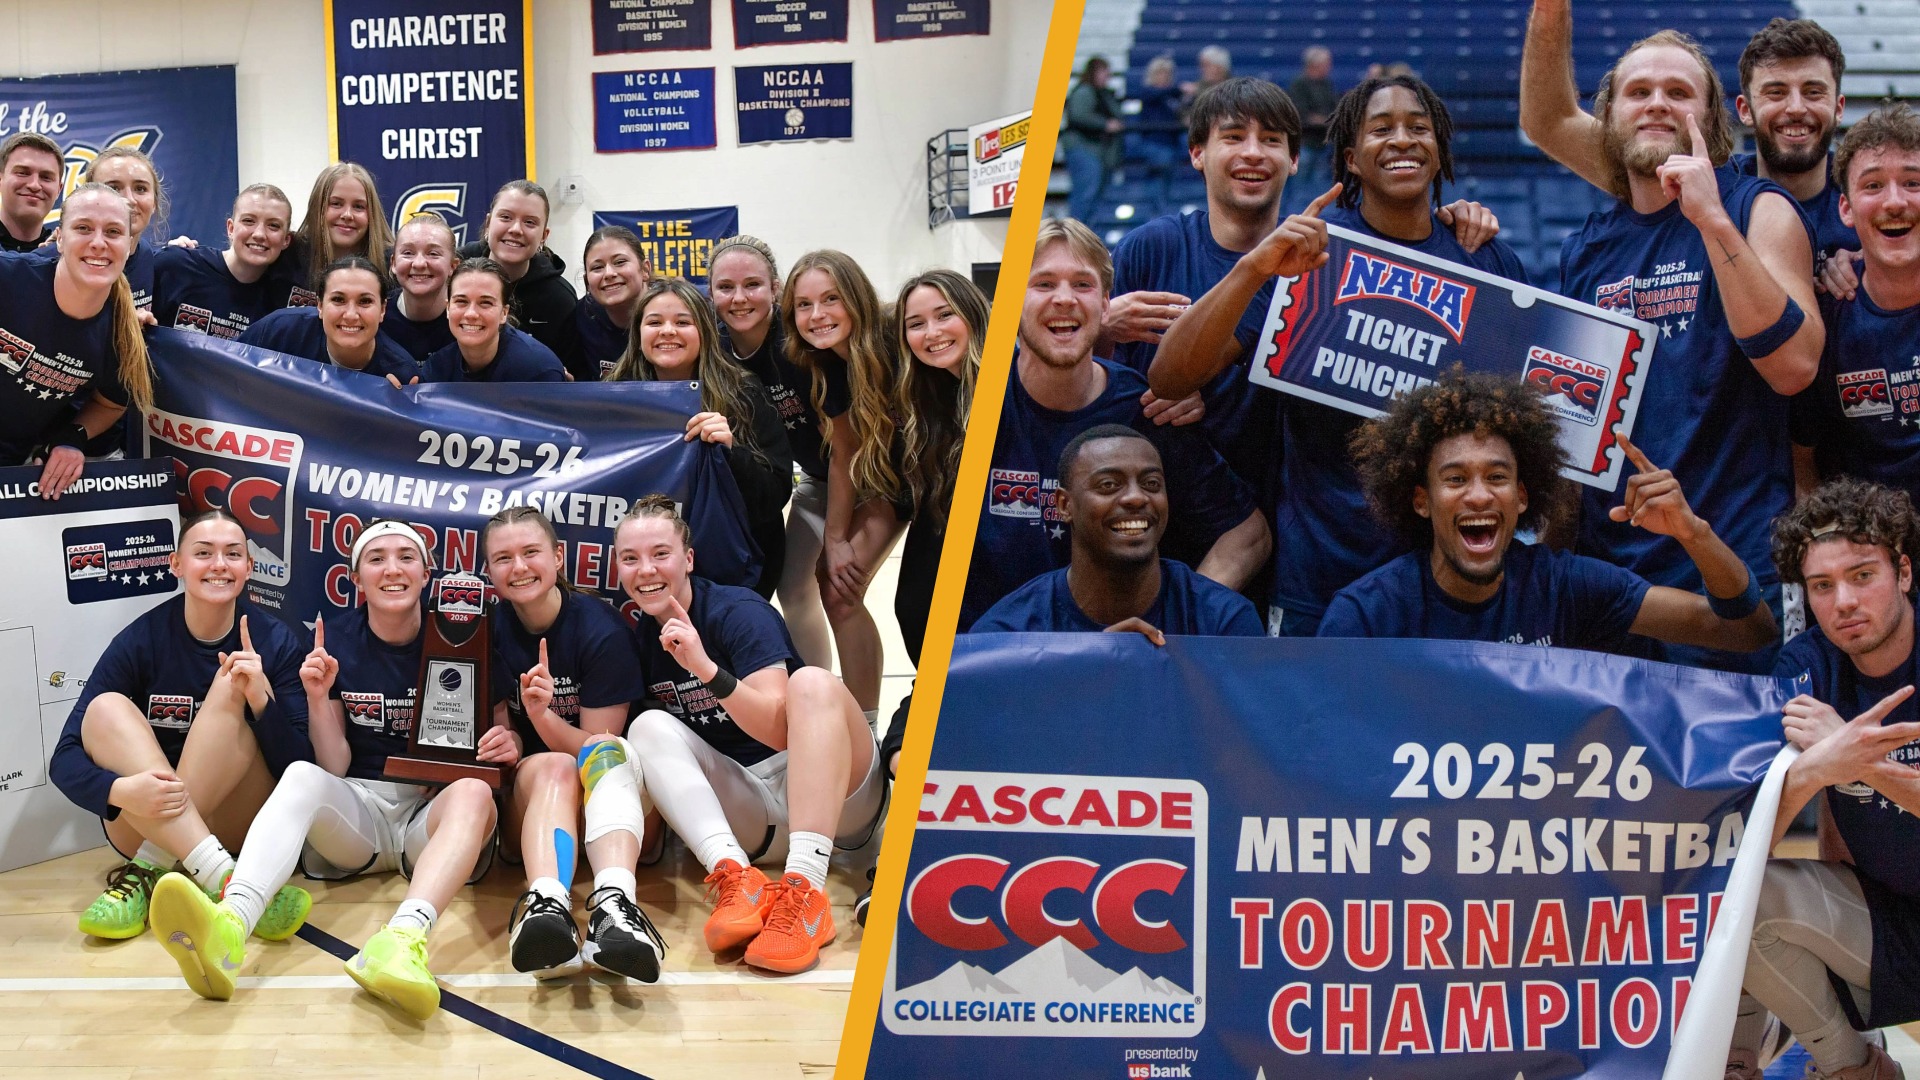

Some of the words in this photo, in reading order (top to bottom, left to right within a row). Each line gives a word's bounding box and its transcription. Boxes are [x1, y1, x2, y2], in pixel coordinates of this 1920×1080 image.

[626, 9, 678, 20] BASKETBALL
[775, 2, 807, 12] SOCCER
[755, 14, 788, 24] DIVISION
[809, 11, 827, 20] MEN
[350, 13, 506, 49] CHARACTER
[617, 22, 650, 32] DIVISION
[658, 20, 687, 30] WOMEN
[624, 71, 682, 86] NCCAA
[763, 69, 825, 87] NCCAA
[342, 69, 518, 106] COMPETENCE
[769, 89, 809, 99] DIVISION
[609, 93, 648, 103] NATIONAL
[653, 89, 700, 100] CHAMPIONS
[624, 106, 685, 118] VOLLEYBALL
[738, 100, 797, 112] BASKETBALL
[800, 98, 850, 108] CHAMPIONS
[19, 101, 68, 134] the
[619, 123, 654, 134] DIVISION
[660, 121, 690, 131] WOMEN
[784, 126, 806, 136] 1977
[382, 127, 483, 160] CHRIST
[644, 138, 667, 147] 1997
[980, 162, 1006, 176] POINT
[637, 219, 692, 238] THE
[1338, 252, 1468, 338] NAIA
[1634, 284, 1700, 305] TOURNAMEN
[1345, 309, 1447, 366] TICKET
[33, 352, 63, 369] WOMEN'S
[55, 352, 84, 368] 2025-26
[1531, 349, 1606, 380] CASCADE
[1312, 346, 1441, 401] PUNCH
[1838, 371, 1885, 384] CASCADE
[1527, 367, 1600, 406] CCC
[1842, 383, 1887, 403] CCC
[148, 413, 294, 463] CASCADE
[417, 430, 584, 478] 2025-26
[309, 462, 470, 512] WOMEN'S
[993, 484, 1038, 503] CCC
[68, 544, 104, 553] CASCADE
[125, 535, 155, 546] 2025-26
[107, 548, 137, 558] WOMEN'S
[138, 544, 174, 554] BASKETBALL
[70, 553, 104, 569] CCC
[441, 580, 482, 588] CASCADE
[247, 584, 277, 598] presented
[277, 590, 285, 601] by
[442, 589, 481, 604] CCC
[151, 705, 190, 719] CCC
[426, 718, 470, 727] TOURNAMENT
[427, 725, 467, 733] CHAMPIONS
[1390, 742, 1653, 802] 2025-26
[915, 782, 1193, 830] CASCADE
[1236, 816, 1431, 875] MEN'S
[1457, 811, 1745, 875] BASKETBA
[906, 853, 1188, 954] CCC
[895, 999, 1036, 1022] COLLEGIATE
[1044, 1001, 1196, 1024] CONFERENCE
[1125, 1047, 1184, 1061] presented
[1184, 1047, 1199, 1061] by
